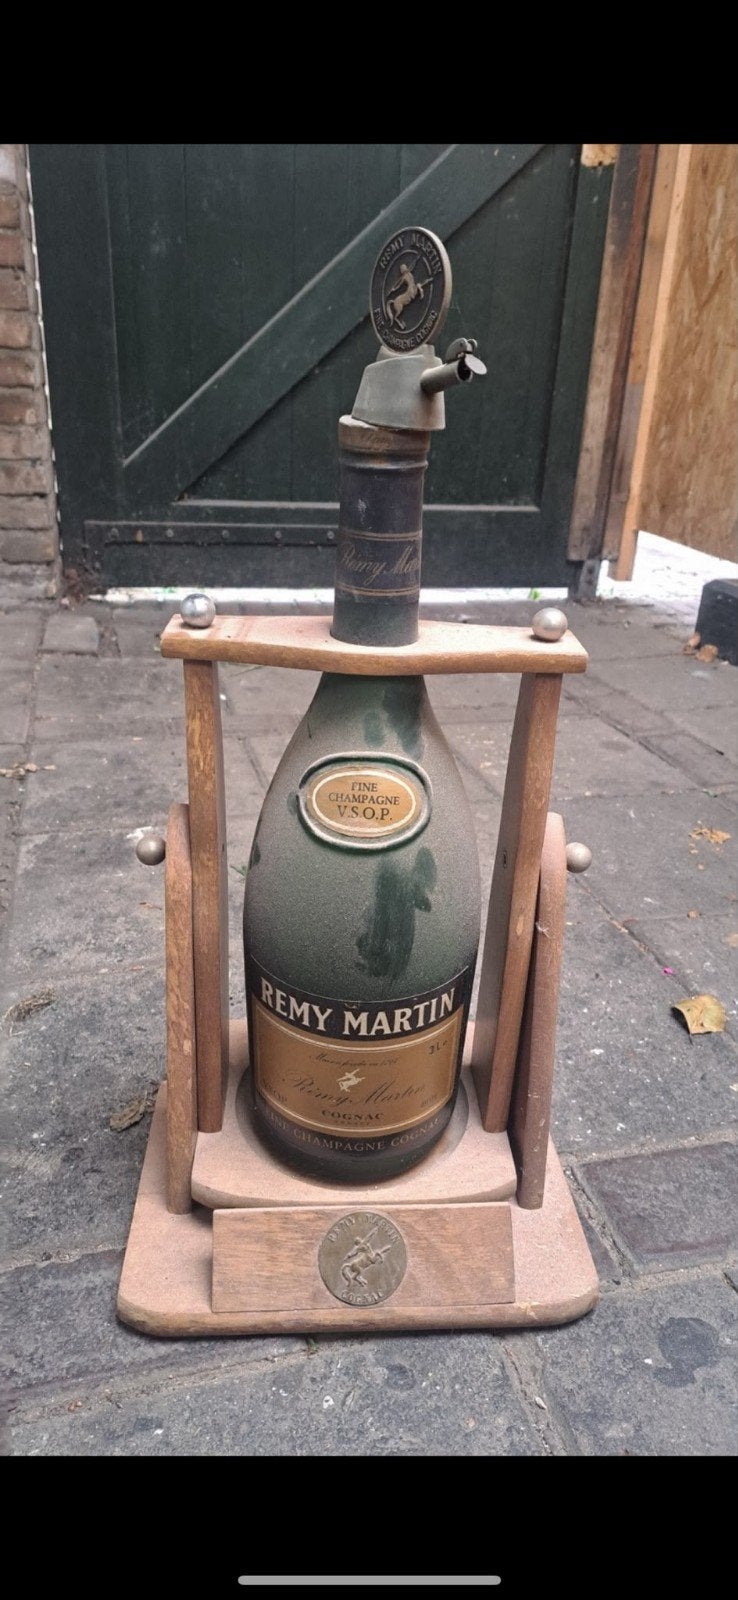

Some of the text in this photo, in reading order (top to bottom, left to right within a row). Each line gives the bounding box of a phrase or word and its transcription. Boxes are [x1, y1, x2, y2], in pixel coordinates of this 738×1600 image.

[411, 233, 442, 274] MARTIN
[351, 782, 378, 792] FINE
[328, 792, 400, 805] CHAMPAGNE
[337, 805, 393, 821] V.S.O.P.
[261, 976, 456, 1037] REMY MARTIN
[357, 1078, 426, 1106] Martin
[321, 1110, 385, 1121] COGNAC
[293, 1127, 386, 1152] CHAMPAGNE
[390, 1116, 441, 1148] COGNAC
